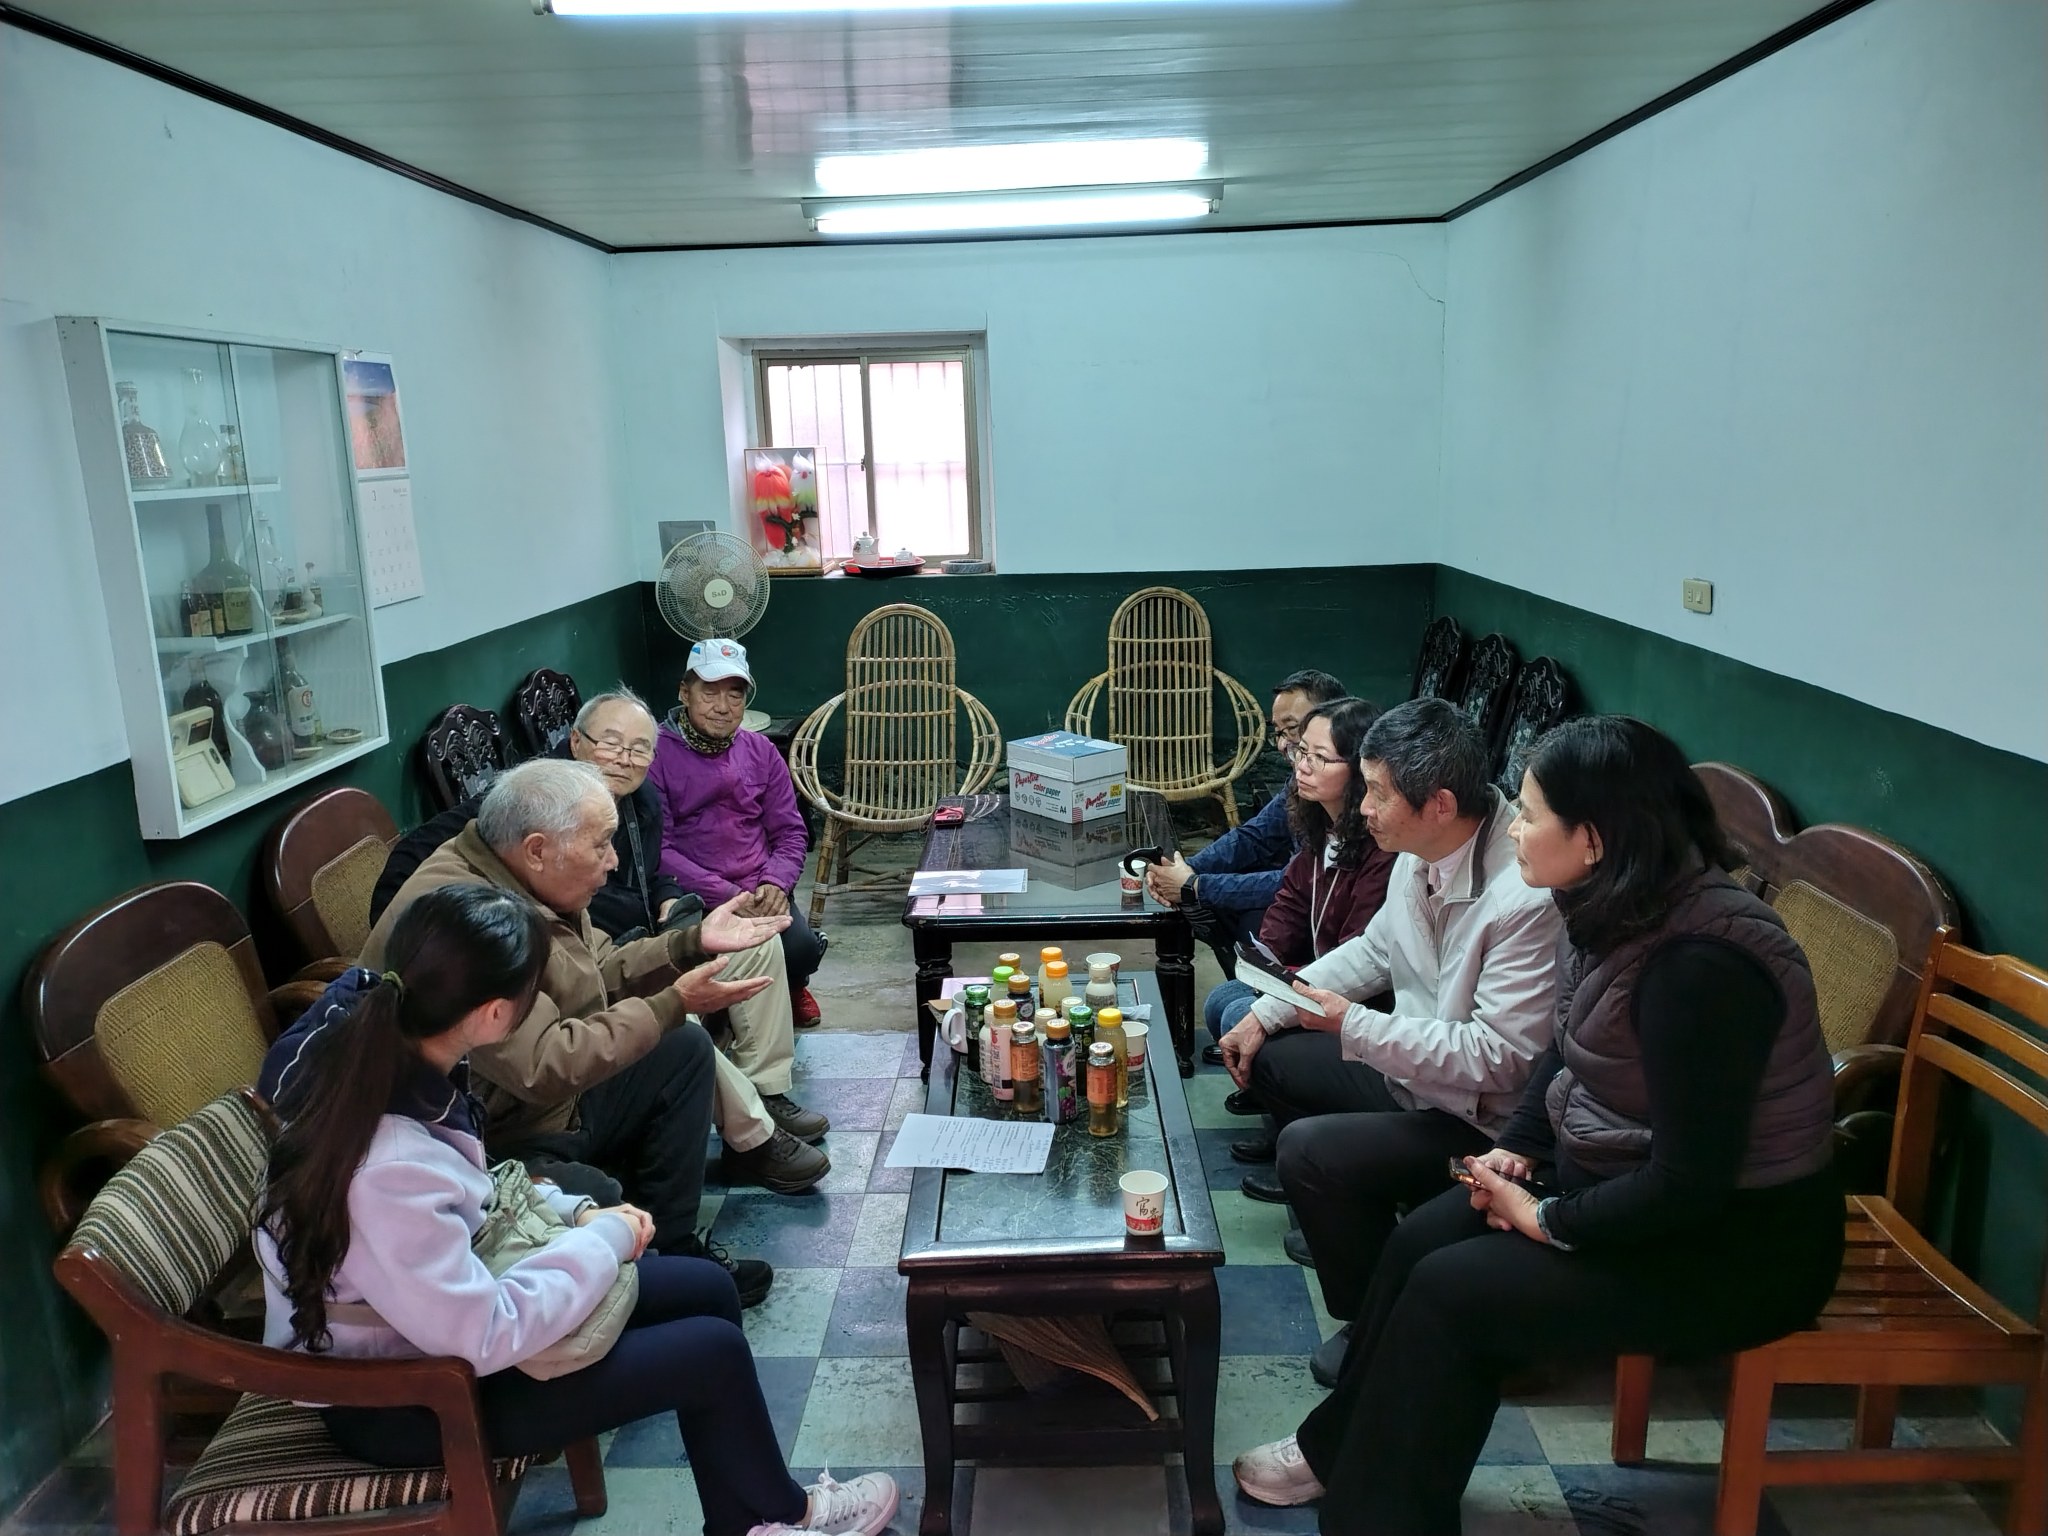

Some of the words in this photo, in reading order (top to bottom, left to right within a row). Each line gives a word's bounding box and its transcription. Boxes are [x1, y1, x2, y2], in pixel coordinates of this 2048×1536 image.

[1033, 783, 1046, 792] color
[1045, 787, 1061, 797] paper
[1095, 800, 1108, 808] color
[1059, 805, 1067, 815] A4
